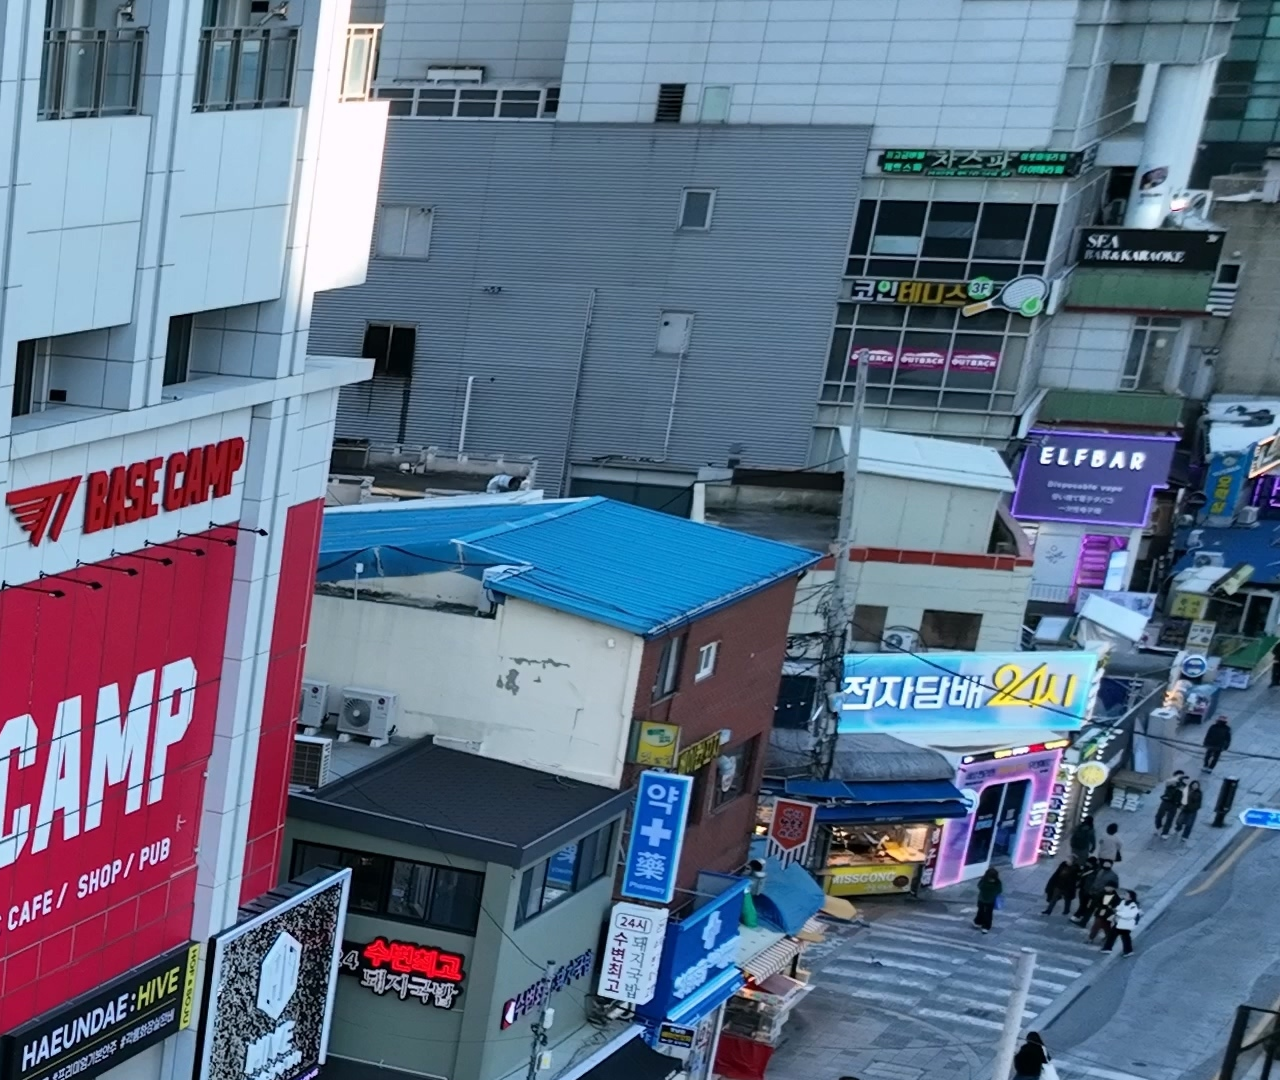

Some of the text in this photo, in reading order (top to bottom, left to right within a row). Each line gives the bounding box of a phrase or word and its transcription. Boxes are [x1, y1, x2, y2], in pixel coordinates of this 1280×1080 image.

[1086, 234, 1120, 249] SEA
[851, 279, 989, 305] 코인테니스 3F
[851, 352, 894, 363] OBACK
[900, 354, 945, 365] OUTBACK
[951, 356, 997, 368] OUTBACK
[1040, 446, 1147, 471] ELFBAR
[83, 456, 163, 534] BASE
[162, 437, 244, 512] CAMP
[841, 661, 1078, 712] 전자담배 24시
[647, 783, 680, 816] 약
[635, 851, 667, 881] 藥
[7, 888, 53, 932] CAFE
[56, 882, 69, 909] /
[77, 857, 123, 900] SHOP
[123, 852, 135, 879] /
[139, 837, 171, 871] PUB
[620, 916, 649, 932] 24시
[363, 937, 463, 982] 수변최고
[605, 931, 629, 995] 수변최고
[624, 936, 649, 999] 돼지국밥
[360, 967, 460, 1009] 돼지국밥
